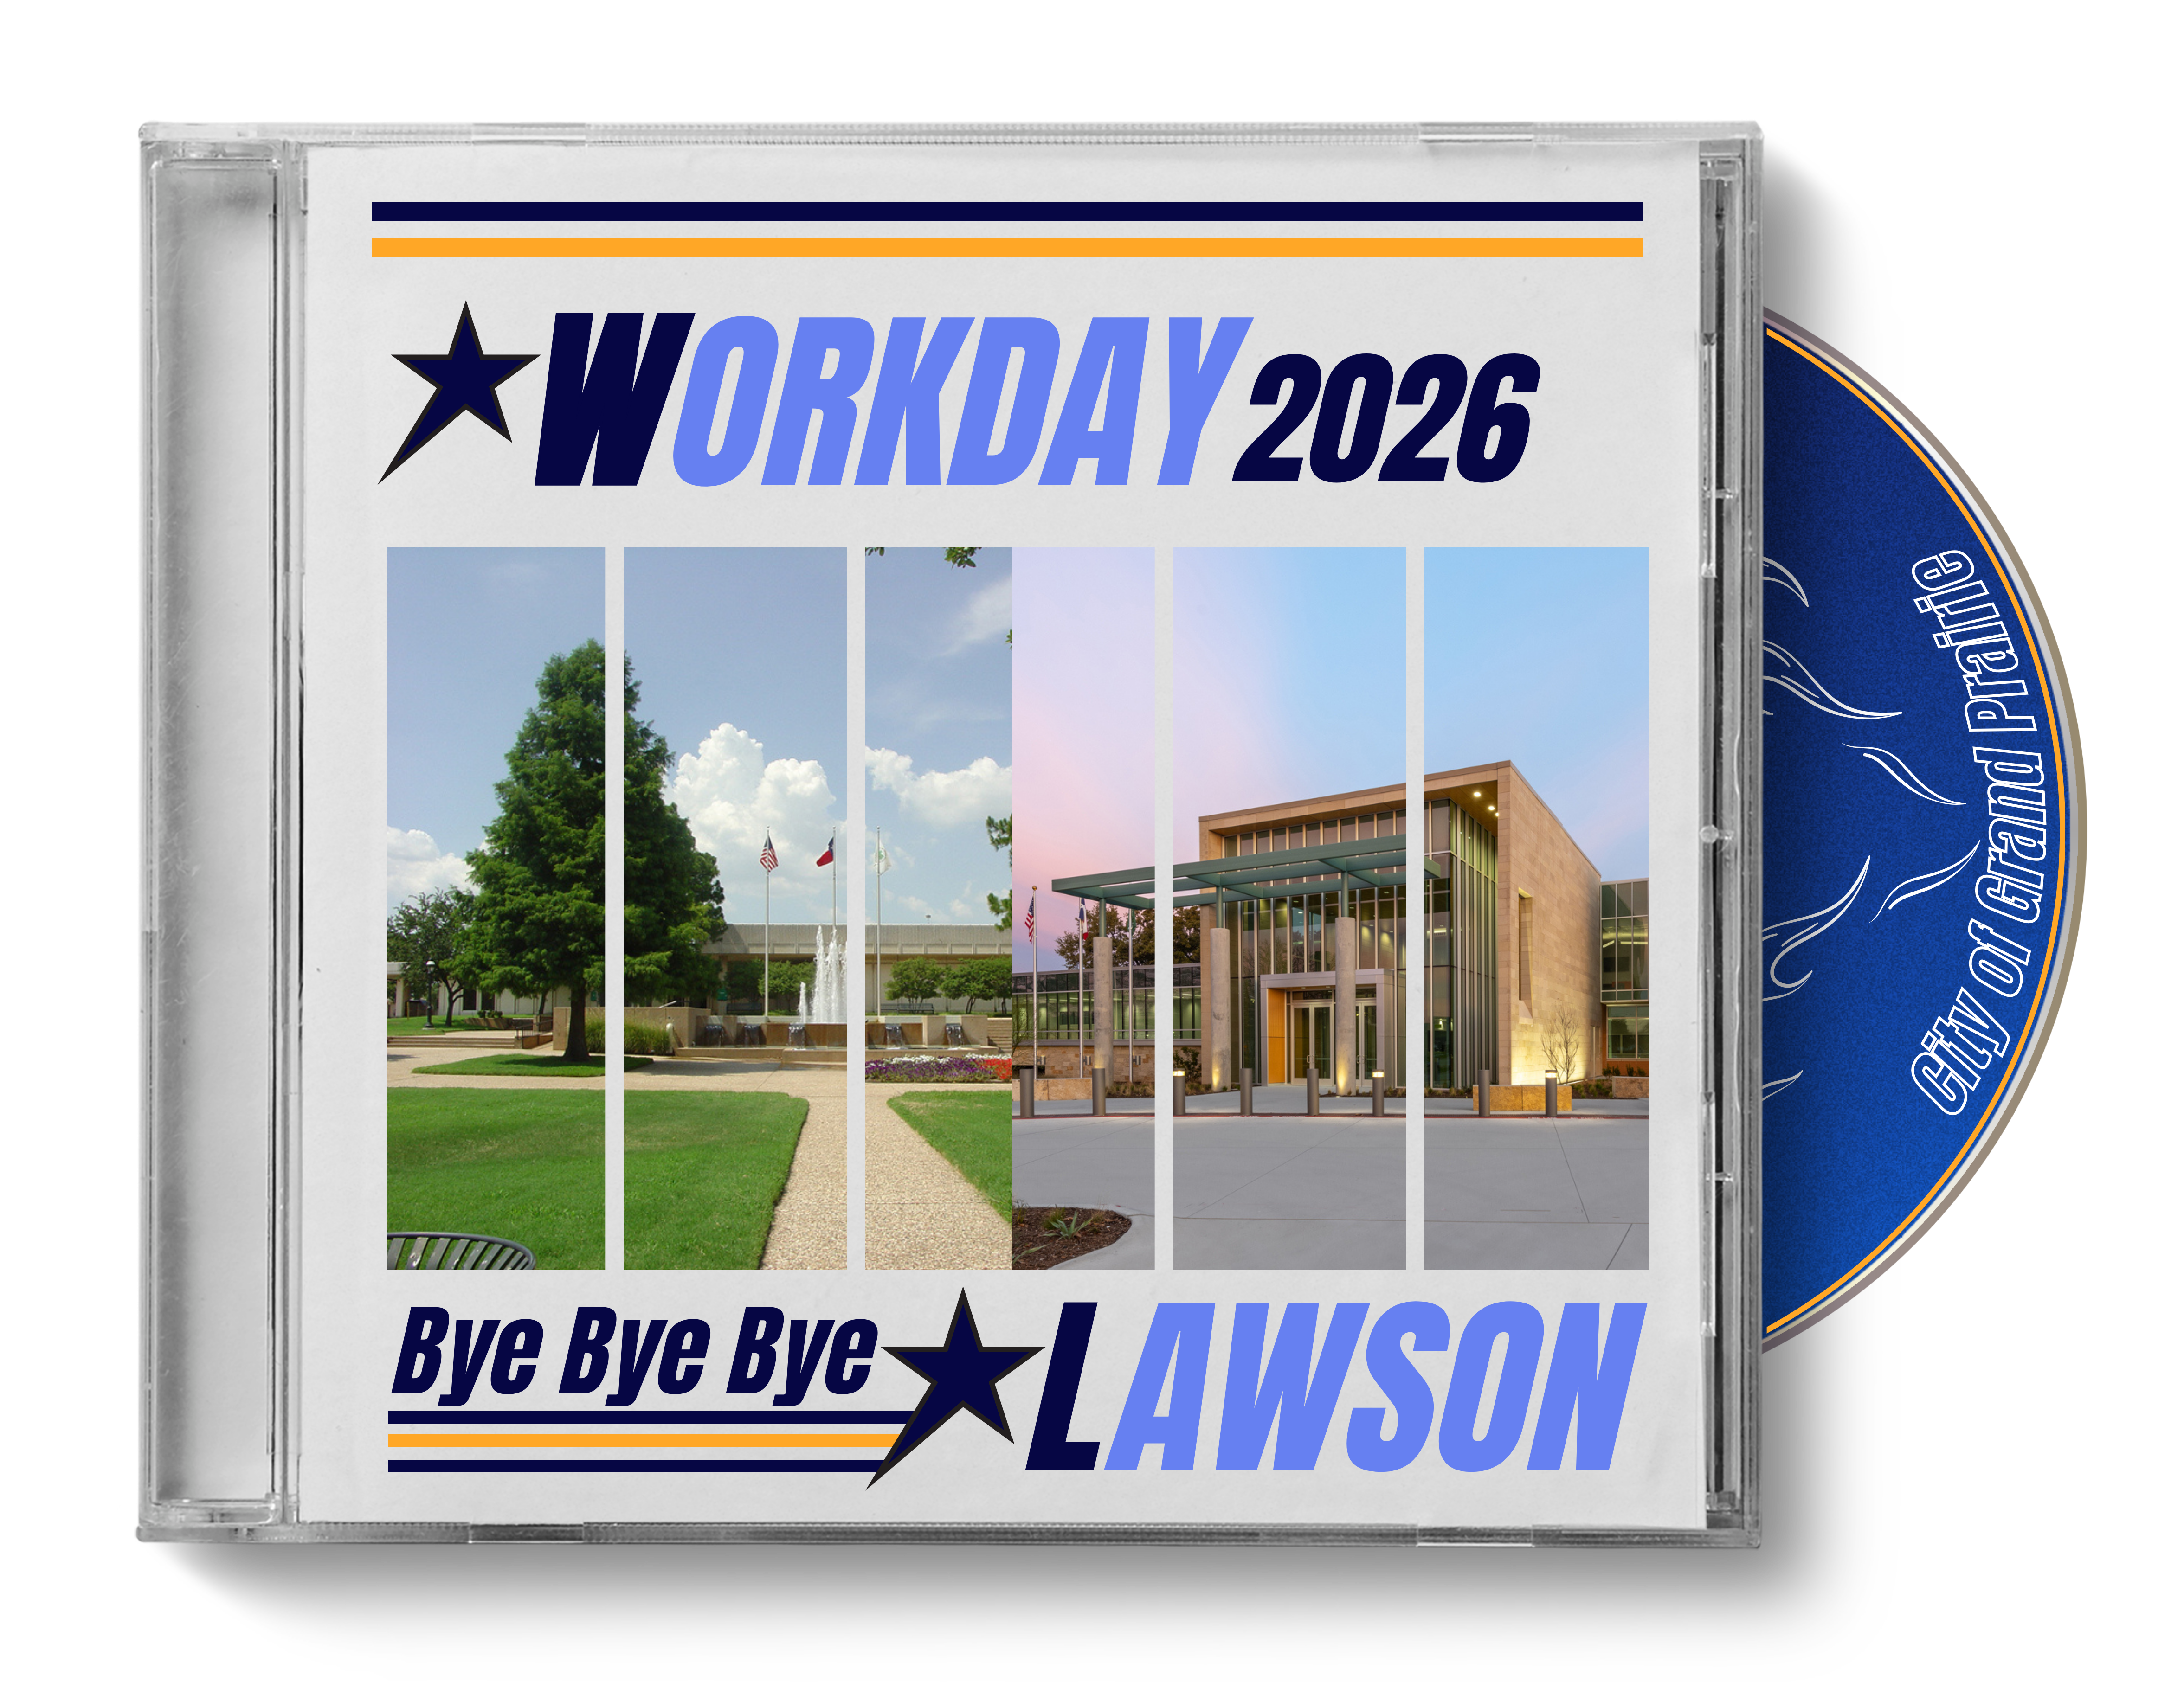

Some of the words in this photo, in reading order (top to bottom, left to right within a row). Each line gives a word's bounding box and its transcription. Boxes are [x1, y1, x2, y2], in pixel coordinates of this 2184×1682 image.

[535, 313, 1254, 487] WORKDAY
[1231, 353, 1540, 483] 2026
[1911, 550, 2038, 732] Prairie
[1972, 746, 2047, 924] Grand
[1968, 918, 2031, 997] of
[1910, 986, 2010, 1116] City
[391, 1307, 543, 1406] Bye
[558, 1307, 710, 1406] Bye
[726, 1307, 878, 1406] Bye
[1025, 1301, 1648, 1472] LAWSON
